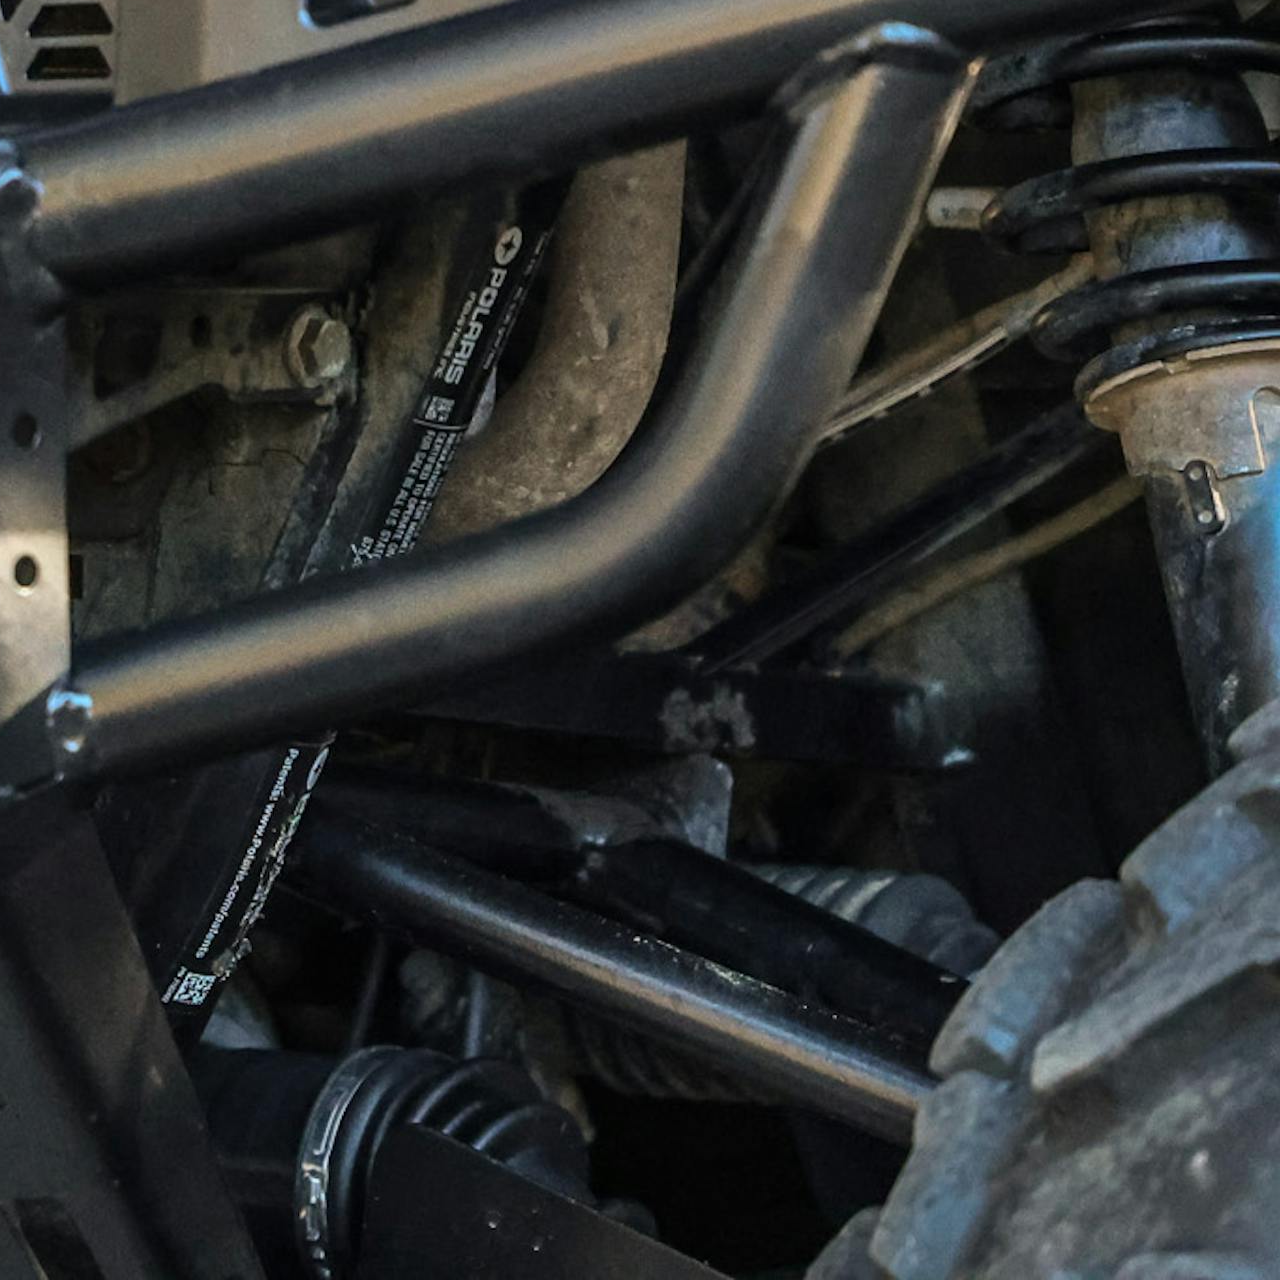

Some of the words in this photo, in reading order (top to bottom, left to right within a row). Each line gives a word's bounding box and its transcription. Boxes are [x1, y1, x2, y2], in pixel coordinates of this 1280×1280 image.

[444, 268, 507, 384] POLARIS
[420, 429, 436, 451] FOR
[420, 432, 447, 480] CERTIFIED
[408, 451, 427, 475] SALE
[412, 483, 425, 497] TO
[196, 803, 276, 959] www.Polaris.com/patents
